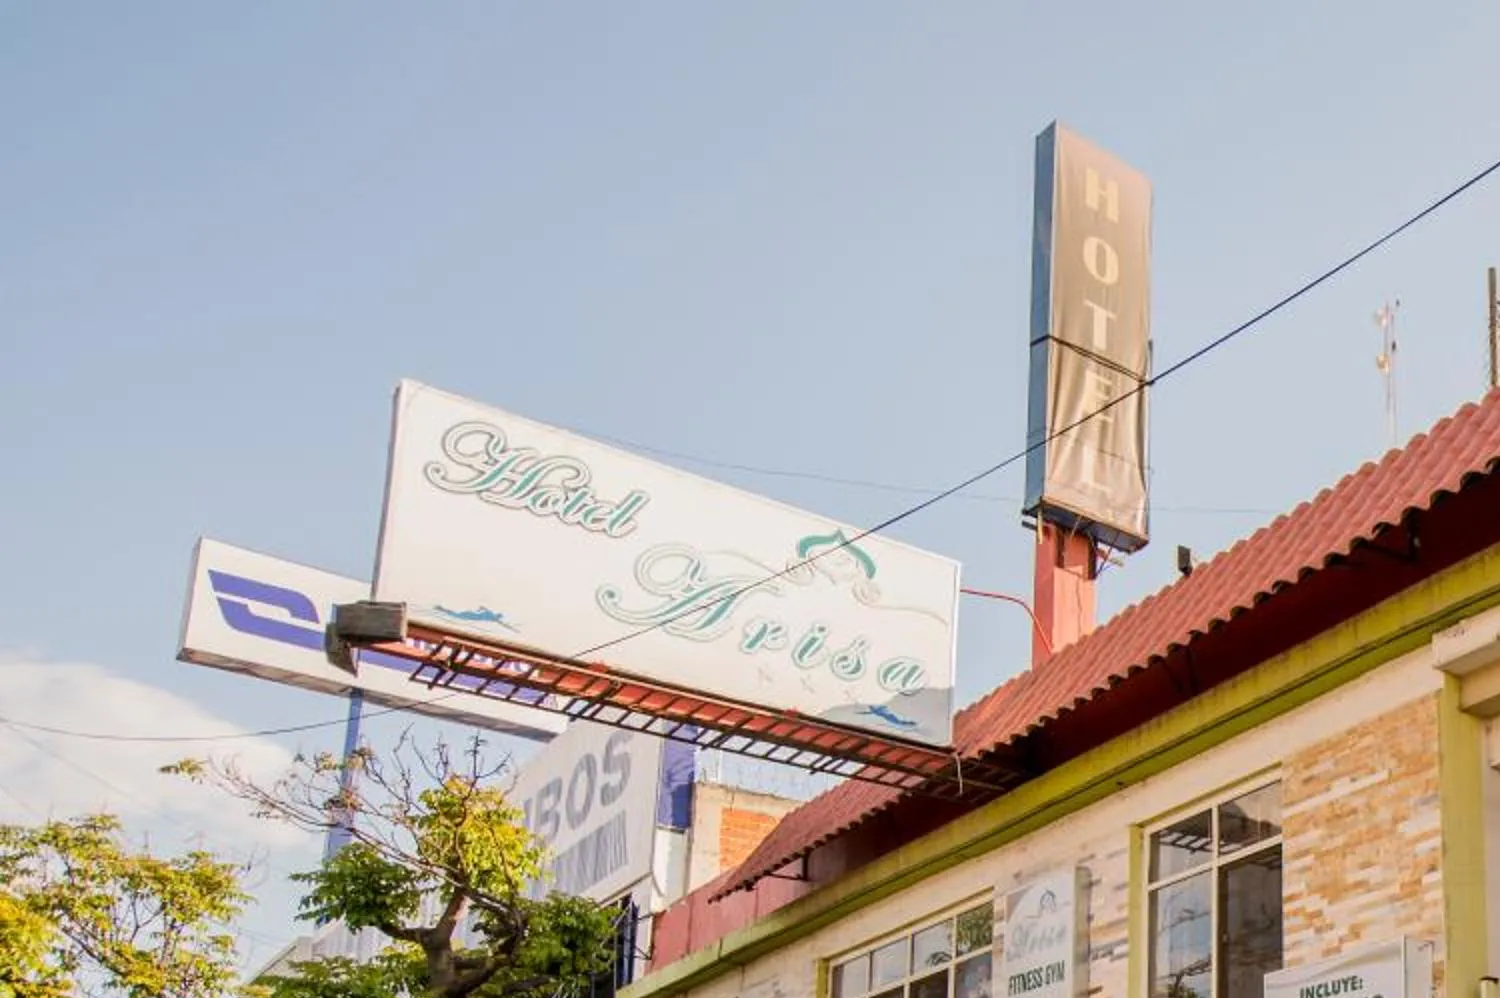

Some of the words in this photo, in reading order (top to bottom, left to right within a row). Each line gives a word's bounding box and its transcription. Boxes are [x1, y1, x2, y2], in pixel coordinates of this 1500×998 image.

[1082, 166, 1119, 494] HOTEL
[423, 420, 651, 538] Hotel
[596, 543, 929, 694] Arisa
[1007, 965, 1044, 997] FITNESS
[1044, 960, 1066, 988] GYM
